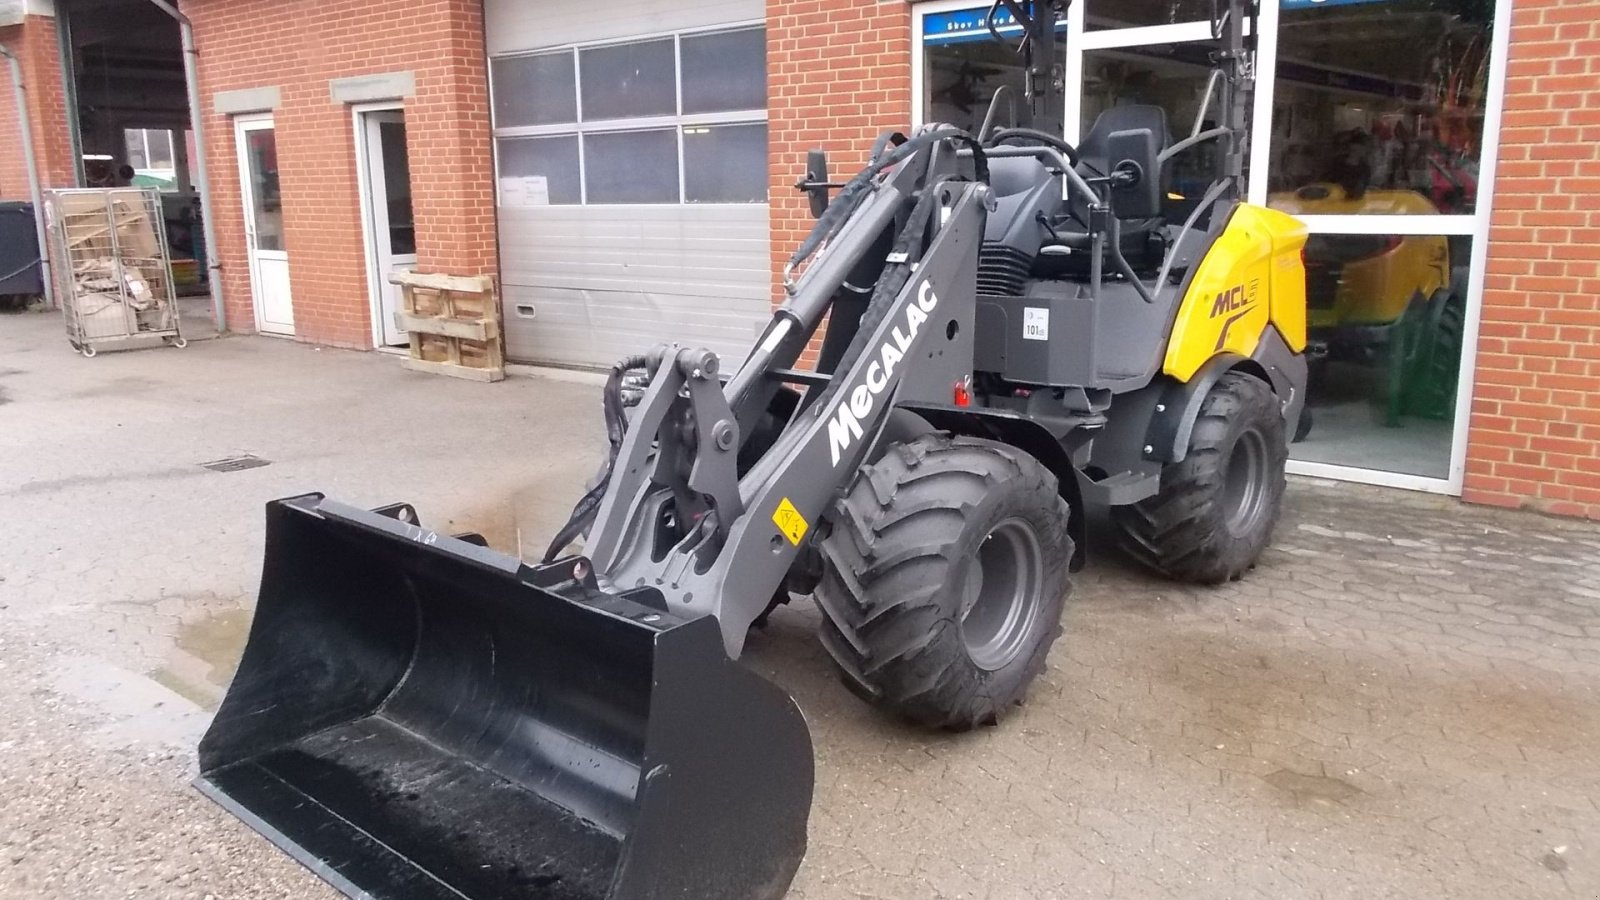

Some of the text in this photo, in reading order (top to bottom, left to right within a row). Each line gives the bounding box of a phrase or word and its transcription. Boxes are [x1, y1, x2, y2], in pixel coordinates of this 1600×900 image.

[978, 17, 1005, 27] Hve
[1210, 284, 1248, 319] MCL
[1027, 324, 1039, 336] 101
